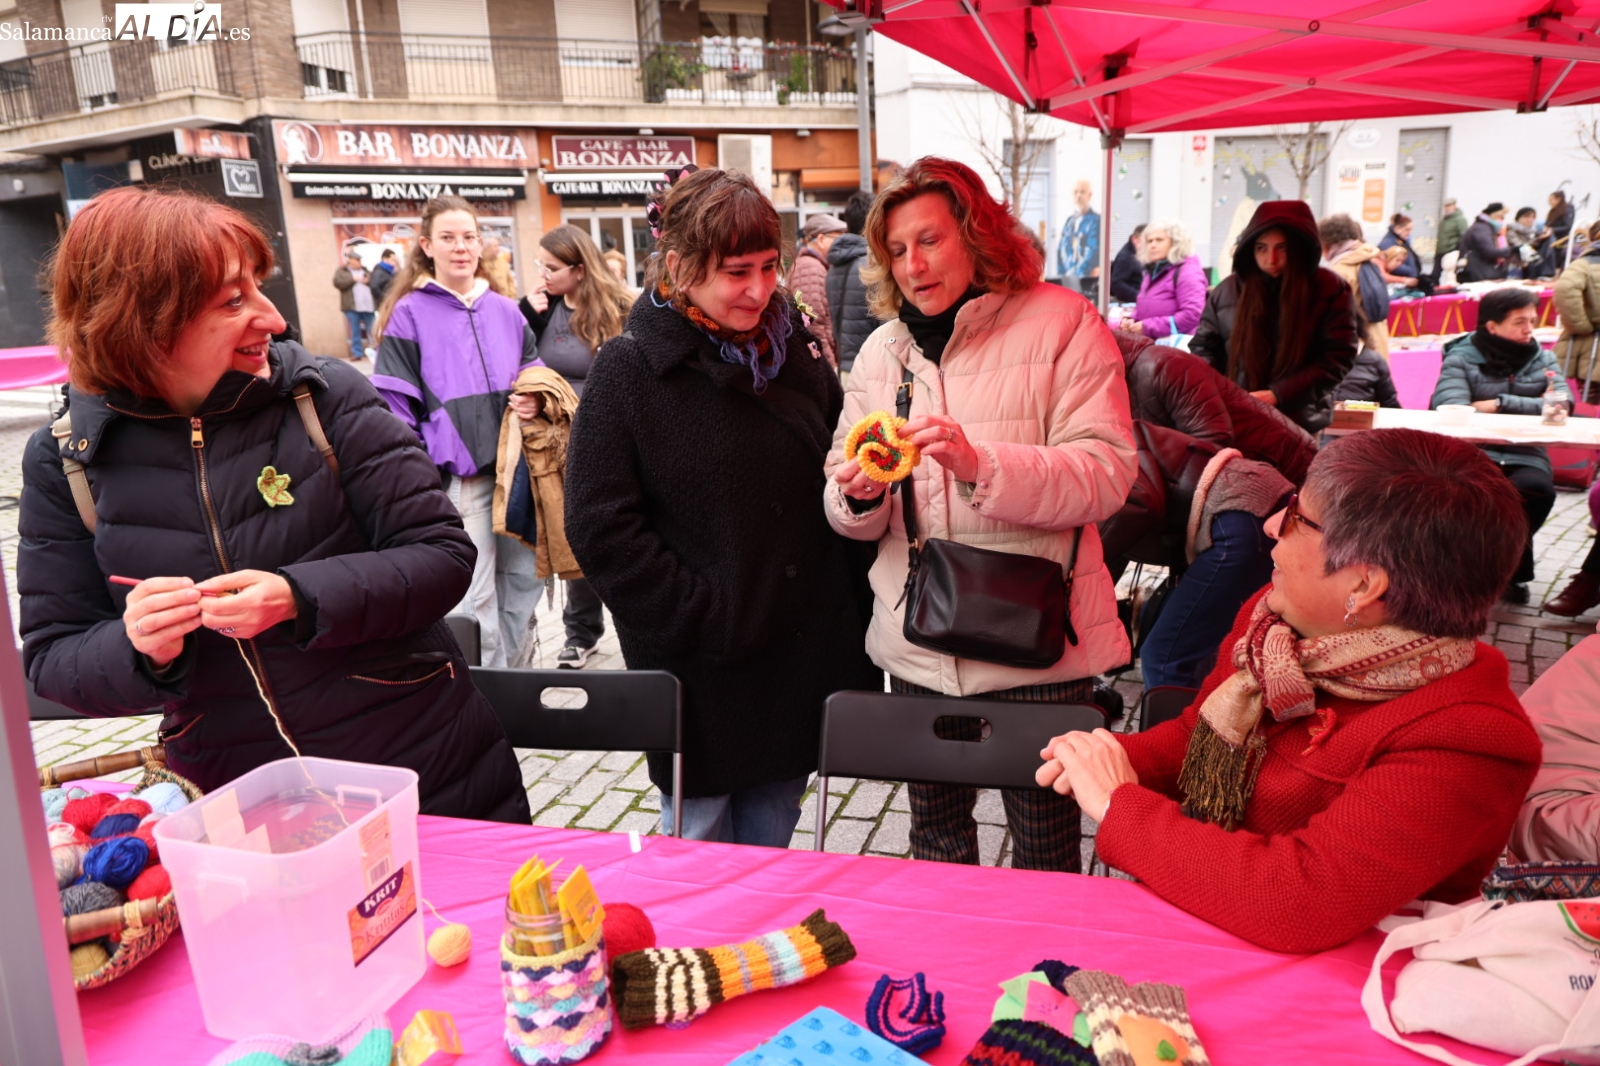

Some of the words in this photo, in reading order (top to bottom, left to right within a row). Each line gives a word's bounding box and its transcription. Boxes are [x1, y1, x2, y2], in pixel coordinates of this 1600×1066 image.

[335, 130, 402, 164] BAR
[411, 132, 528, 161] BONANZA
[580, 140, 623, 151] CAFE
[637, 140, 669, 151] BAR
[560, 151, 692, 166] BONANZA
[370, 183, 454, 200] BONANZA
[602, 181, 654, 194] BONANZA
[331, 201, 408, 213] COMBINADOS
[364, 877, 397, 913] KRIT
[365, 903, 406, 943] Krititas
